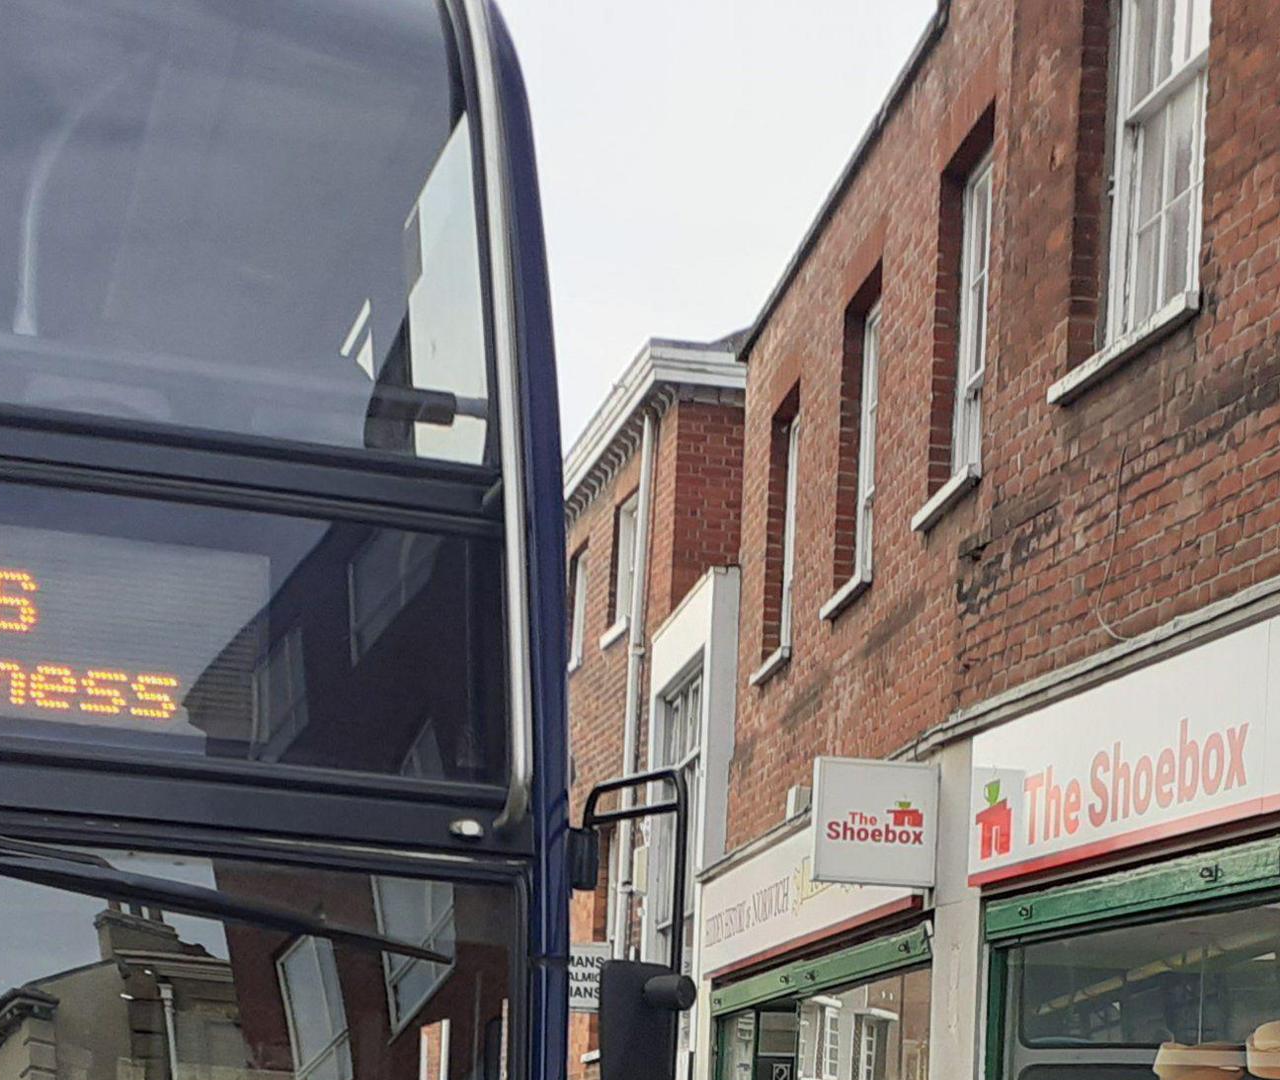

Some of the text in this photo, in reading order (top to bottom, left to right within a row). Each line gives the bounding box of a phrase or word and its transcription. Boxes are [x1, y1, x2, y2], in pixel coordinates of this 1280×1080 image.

[1024, 764, 1081, 845] The
[1087, 718, 1249, 828] Shoebox
[848, 811, 877, 826] The
[826, 821, 923, 845] Shoebox
